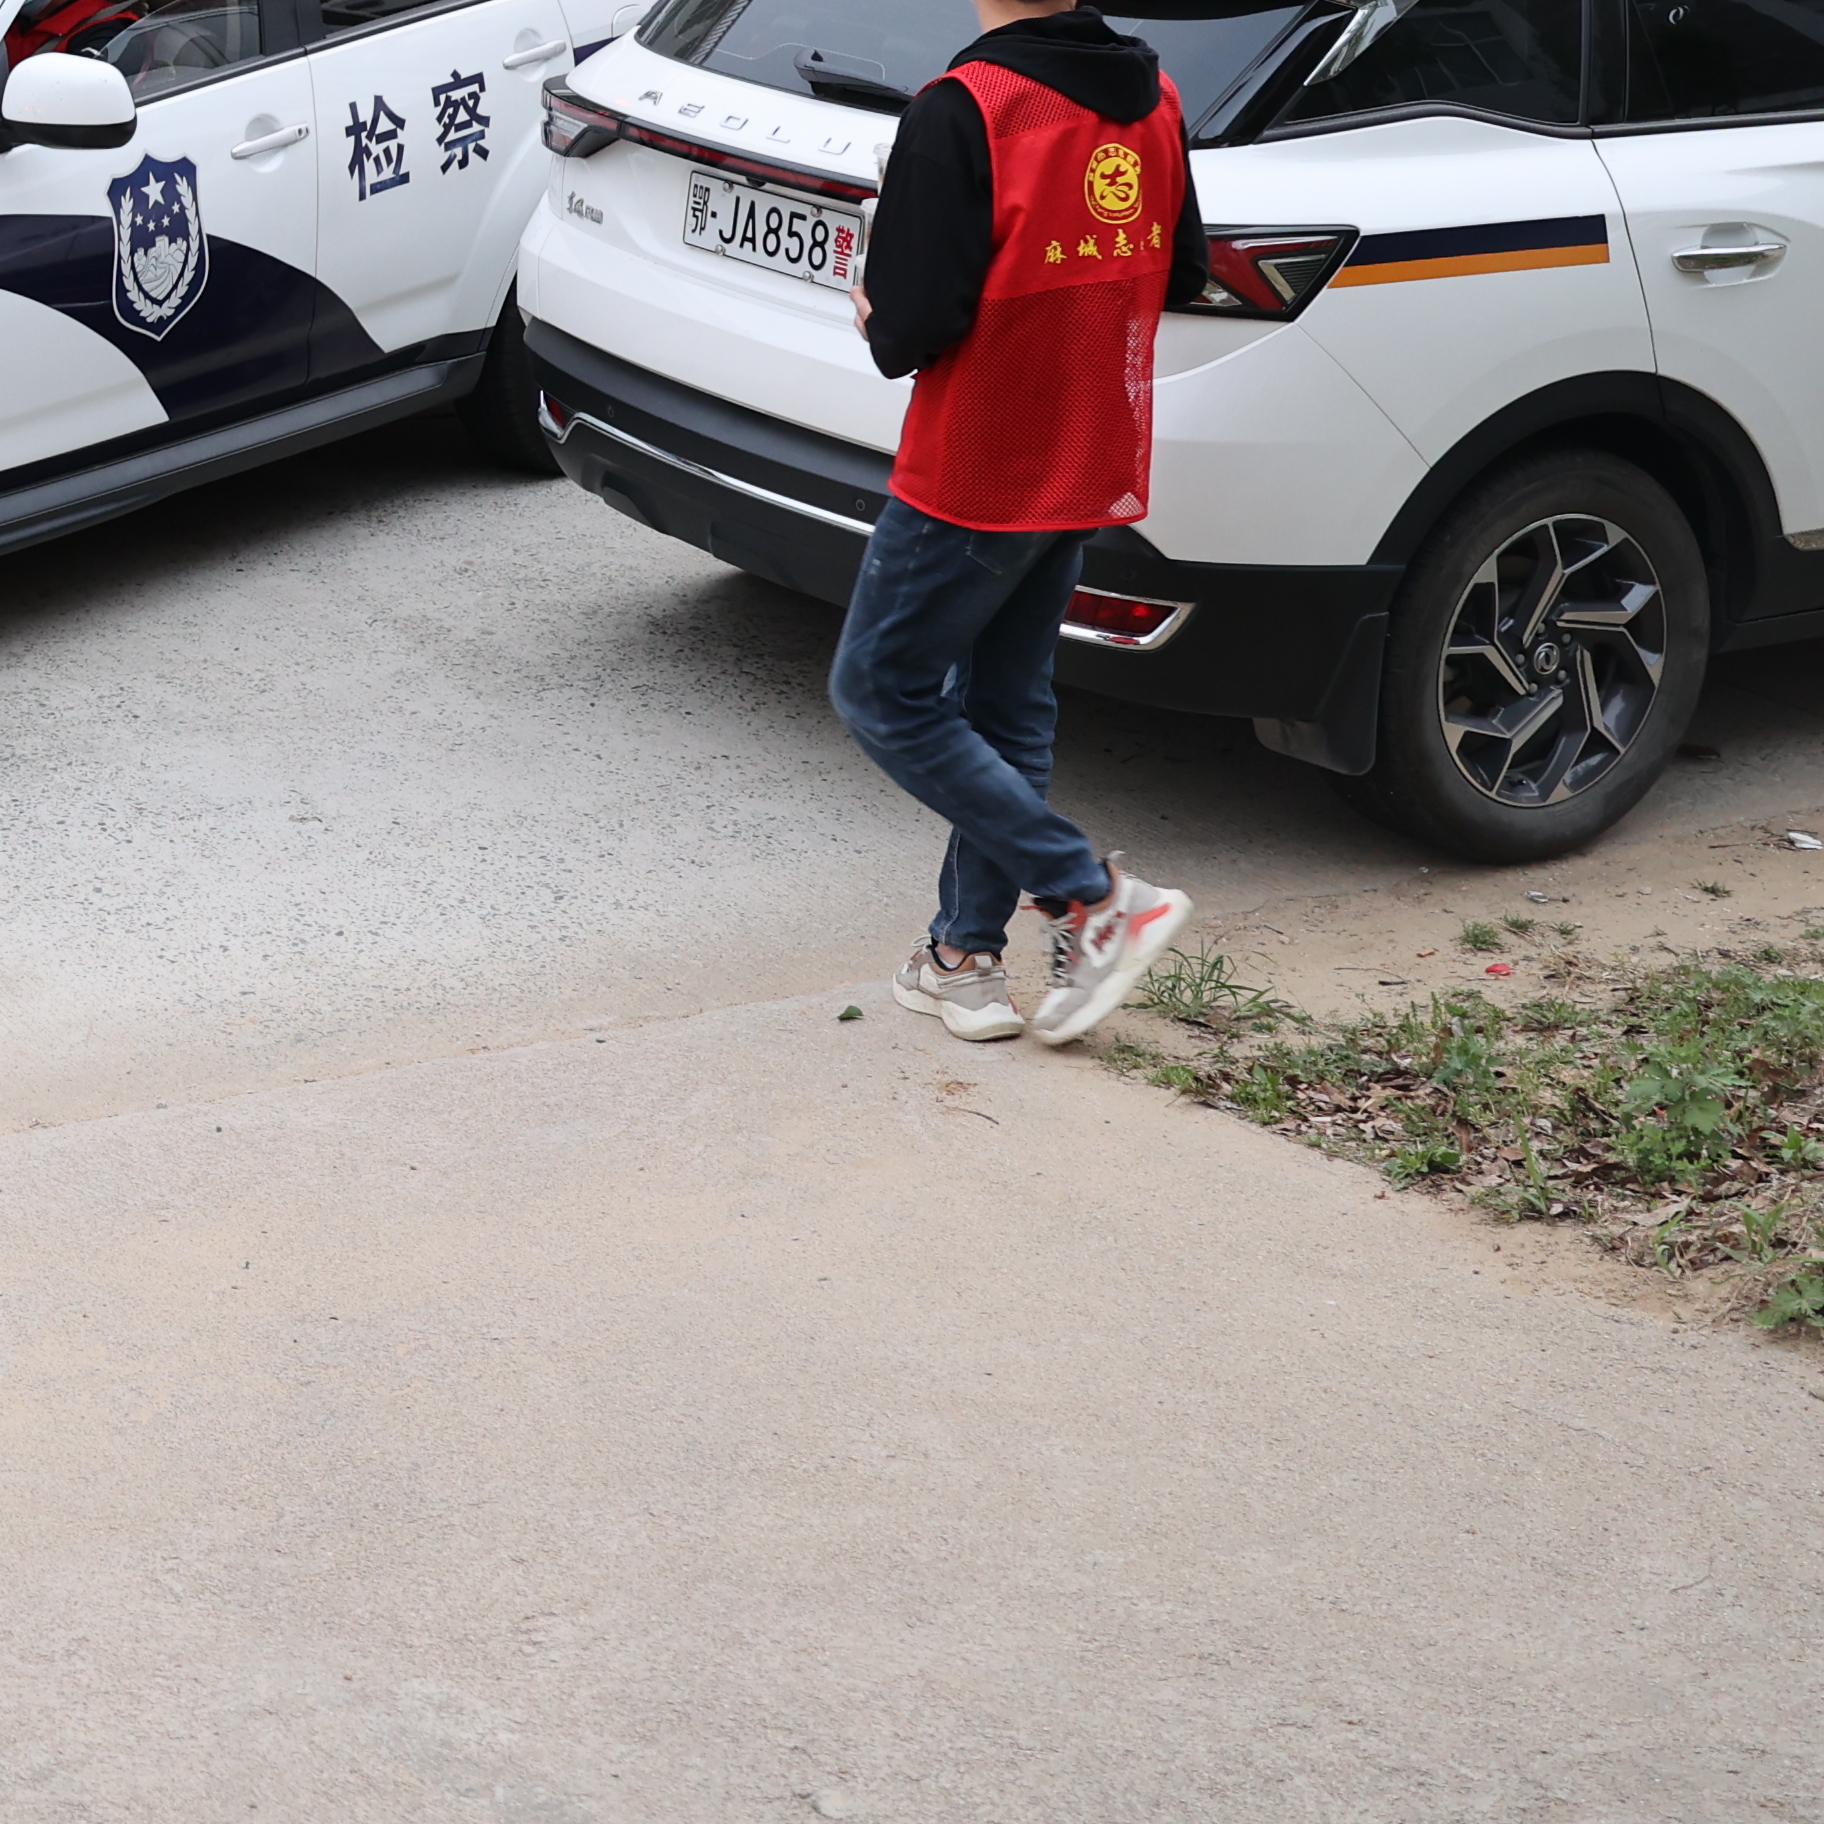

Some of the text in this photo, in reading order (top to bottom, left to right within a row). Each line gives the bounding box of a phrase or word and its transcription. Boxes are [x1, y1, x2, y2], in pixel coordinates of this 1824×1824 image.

[344, 68, 491, 203] 检察
[638, 89, 852, 156] AEOLU
[1042, 221, 1163, 266] 麻城志者
